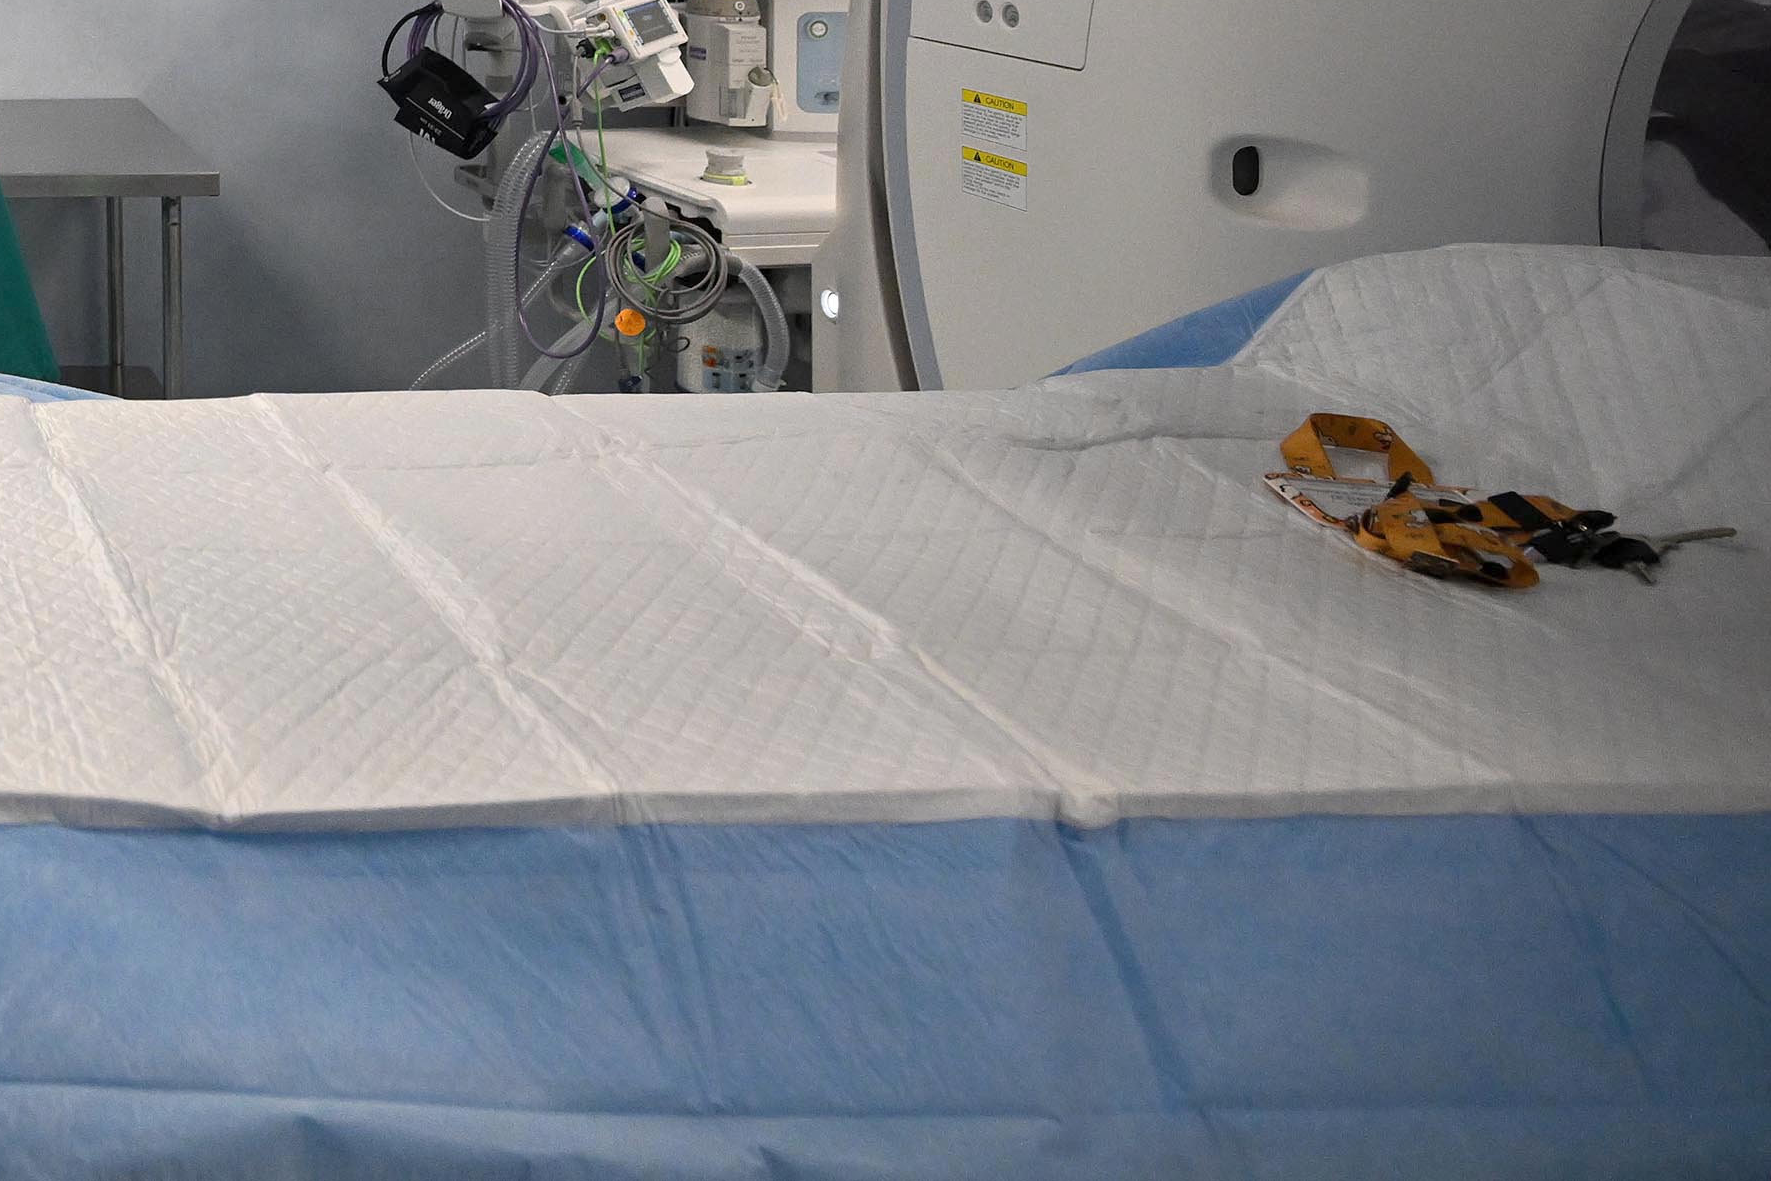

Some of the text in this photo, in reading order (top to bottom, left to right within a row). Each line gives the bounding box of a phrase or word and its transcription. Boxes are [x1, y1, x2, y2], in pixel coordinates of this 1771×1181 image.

[428, 98, 452, 120] Dräger
[985, 97, 1015, 110] CAUTION
[985, 155, 1015, 170] CAUTION
